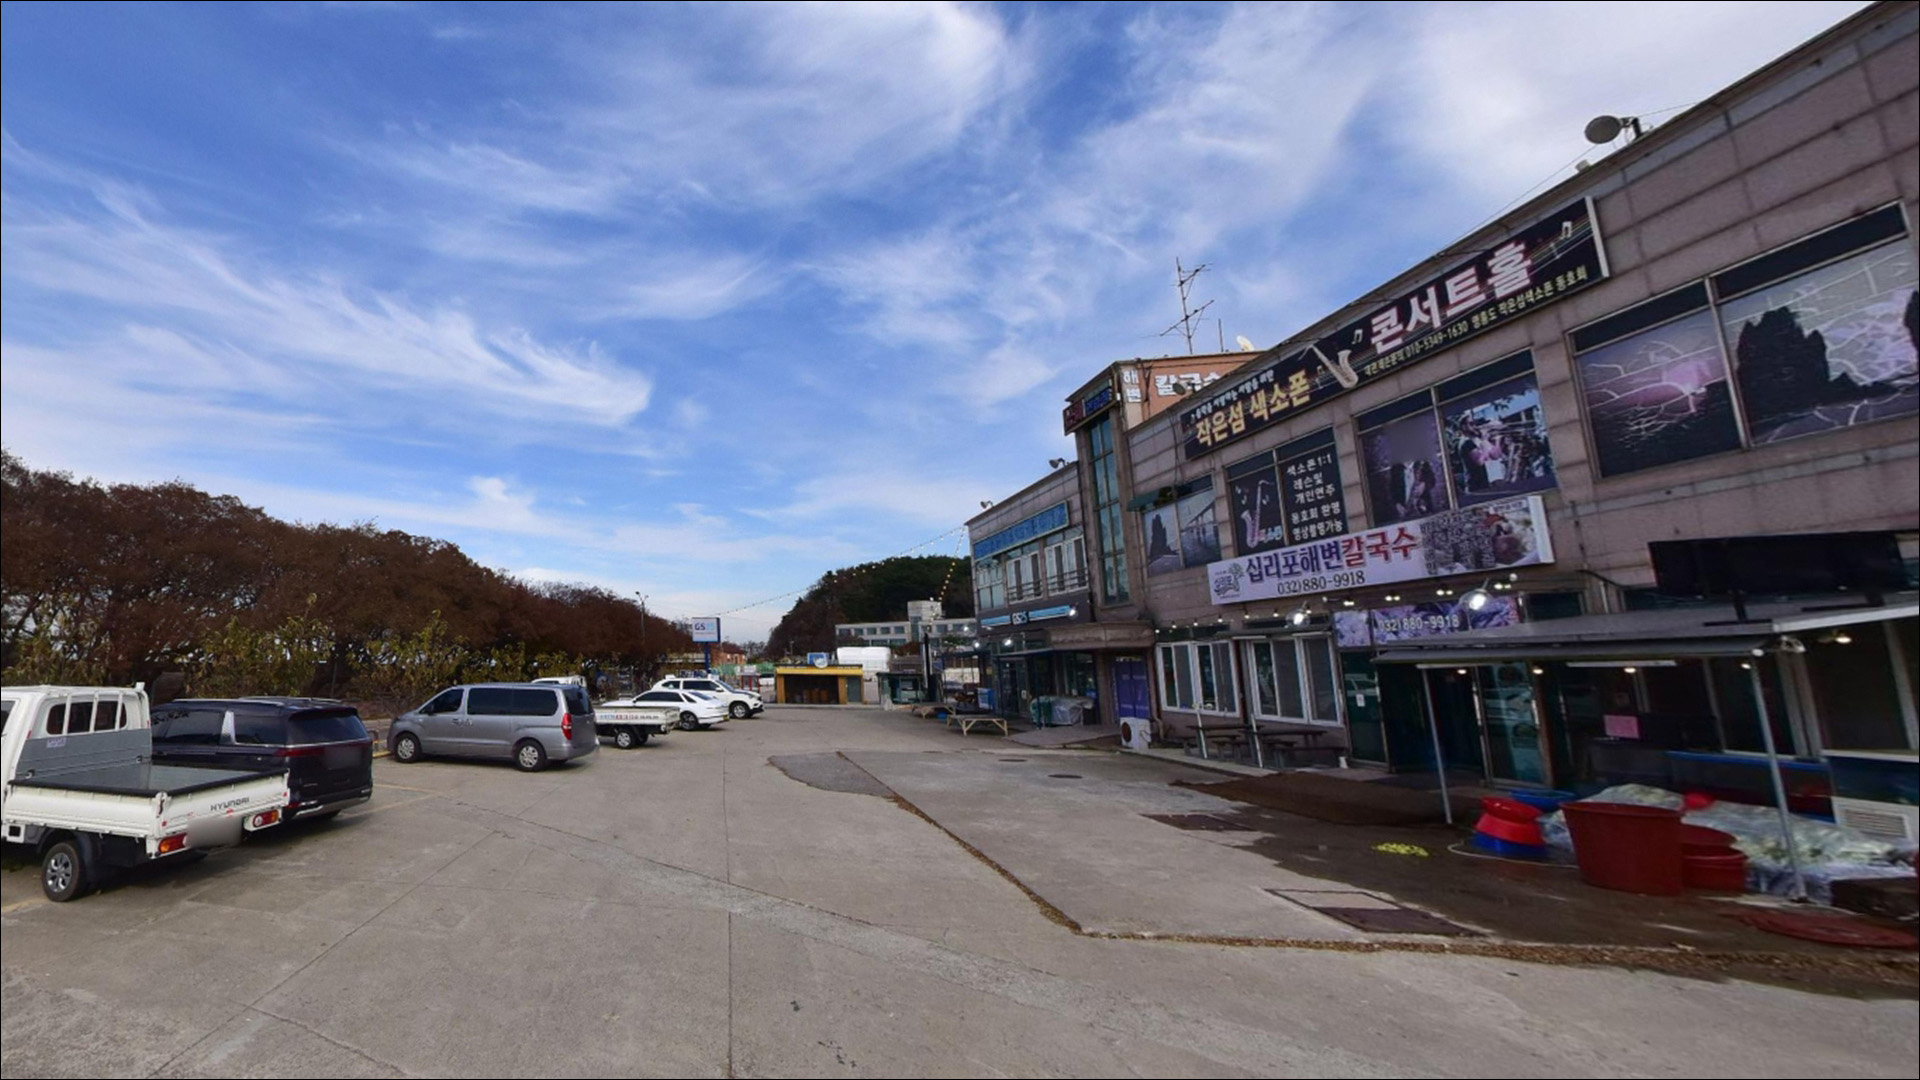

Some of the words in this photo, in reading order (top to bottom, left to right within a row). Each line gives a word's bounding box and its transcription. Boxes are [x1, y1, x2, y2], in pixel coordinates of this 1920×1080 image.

[1371, 242, 1532, 354] 콘서트홀
[1196, 401, 1246, 446] 작은섬
[1249, 369, 1311, 420] 색소폰
[1278, 570, 1366, 595] 032)880-9918
[210, 797, 250, 811] HYUNDAI
